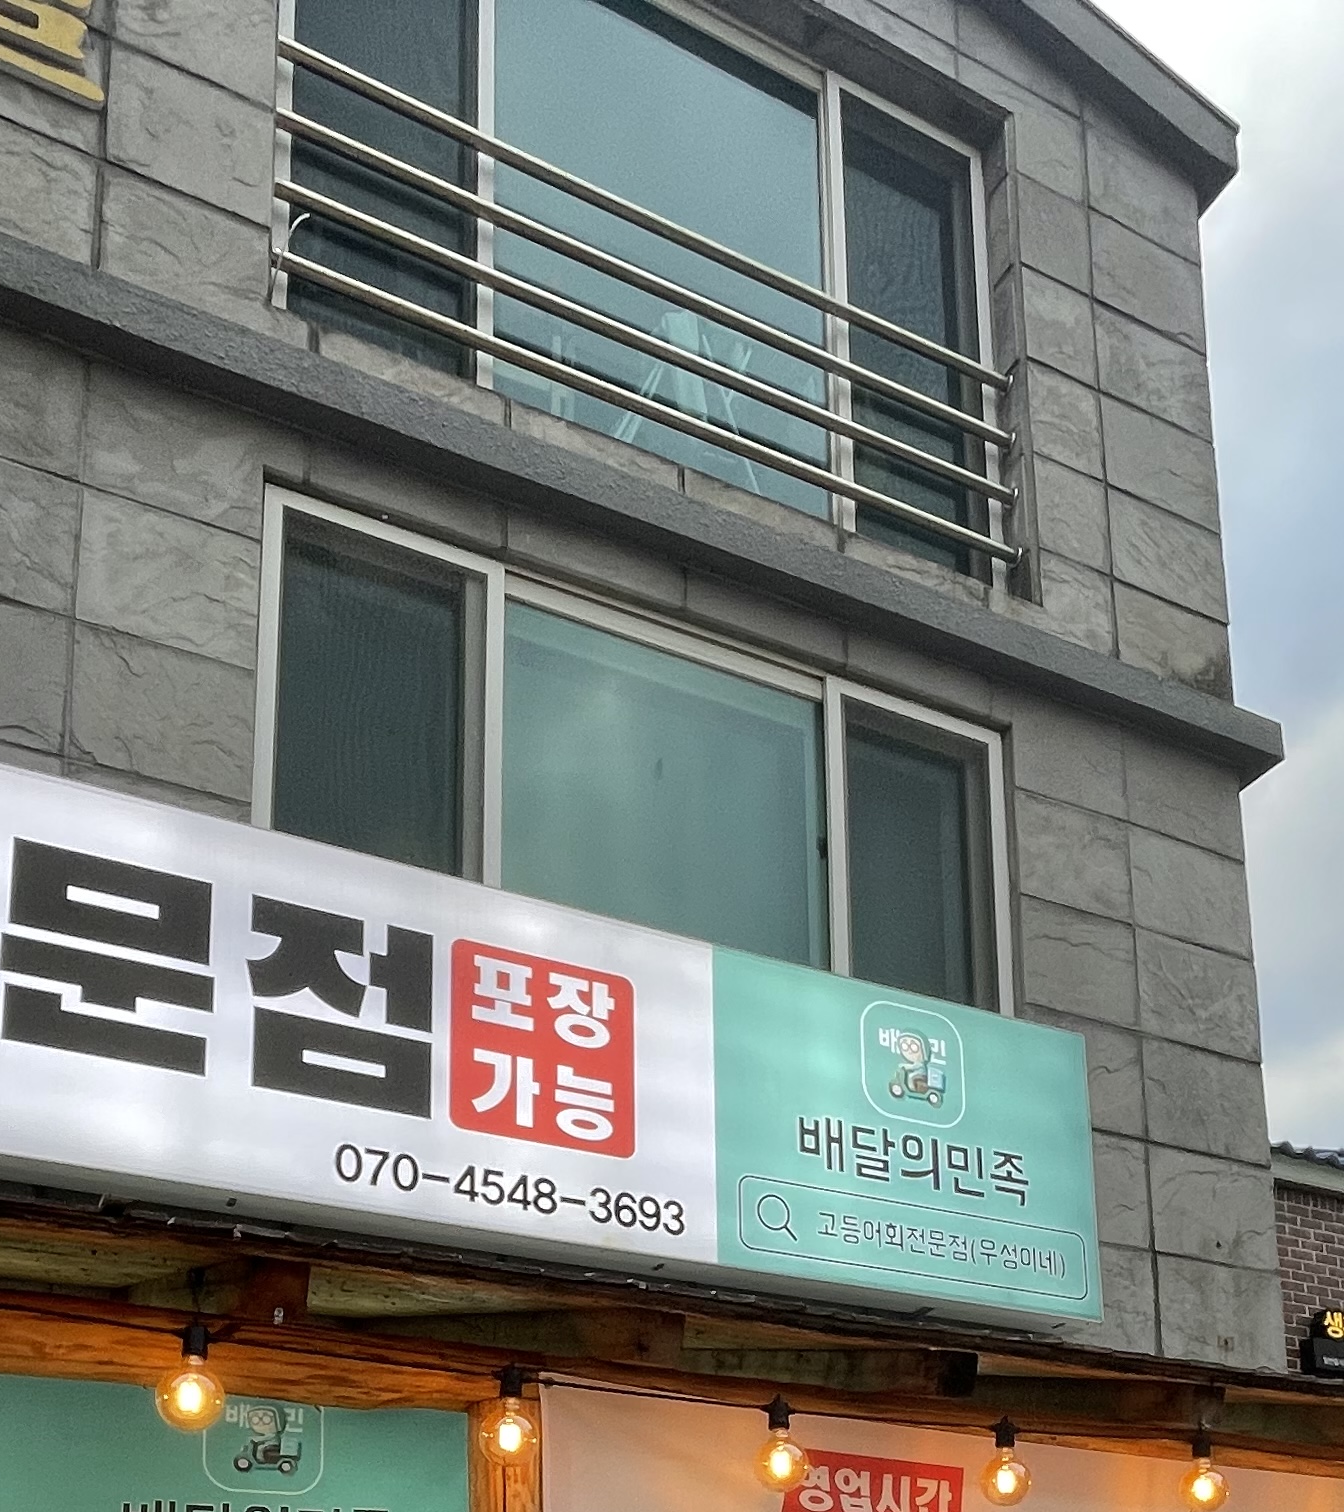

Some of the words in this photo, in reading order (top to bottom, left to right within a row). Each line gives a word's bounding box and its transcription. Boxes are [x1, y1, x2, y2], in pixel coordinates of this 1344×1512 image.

[470, 954, 616, 1050] 포장
[470, 1048, 616, 1142] 가능
[333, 1143, 686, 1236] 070-4548-3693
[797, 1115, 1032, 1207] 배달의민족
